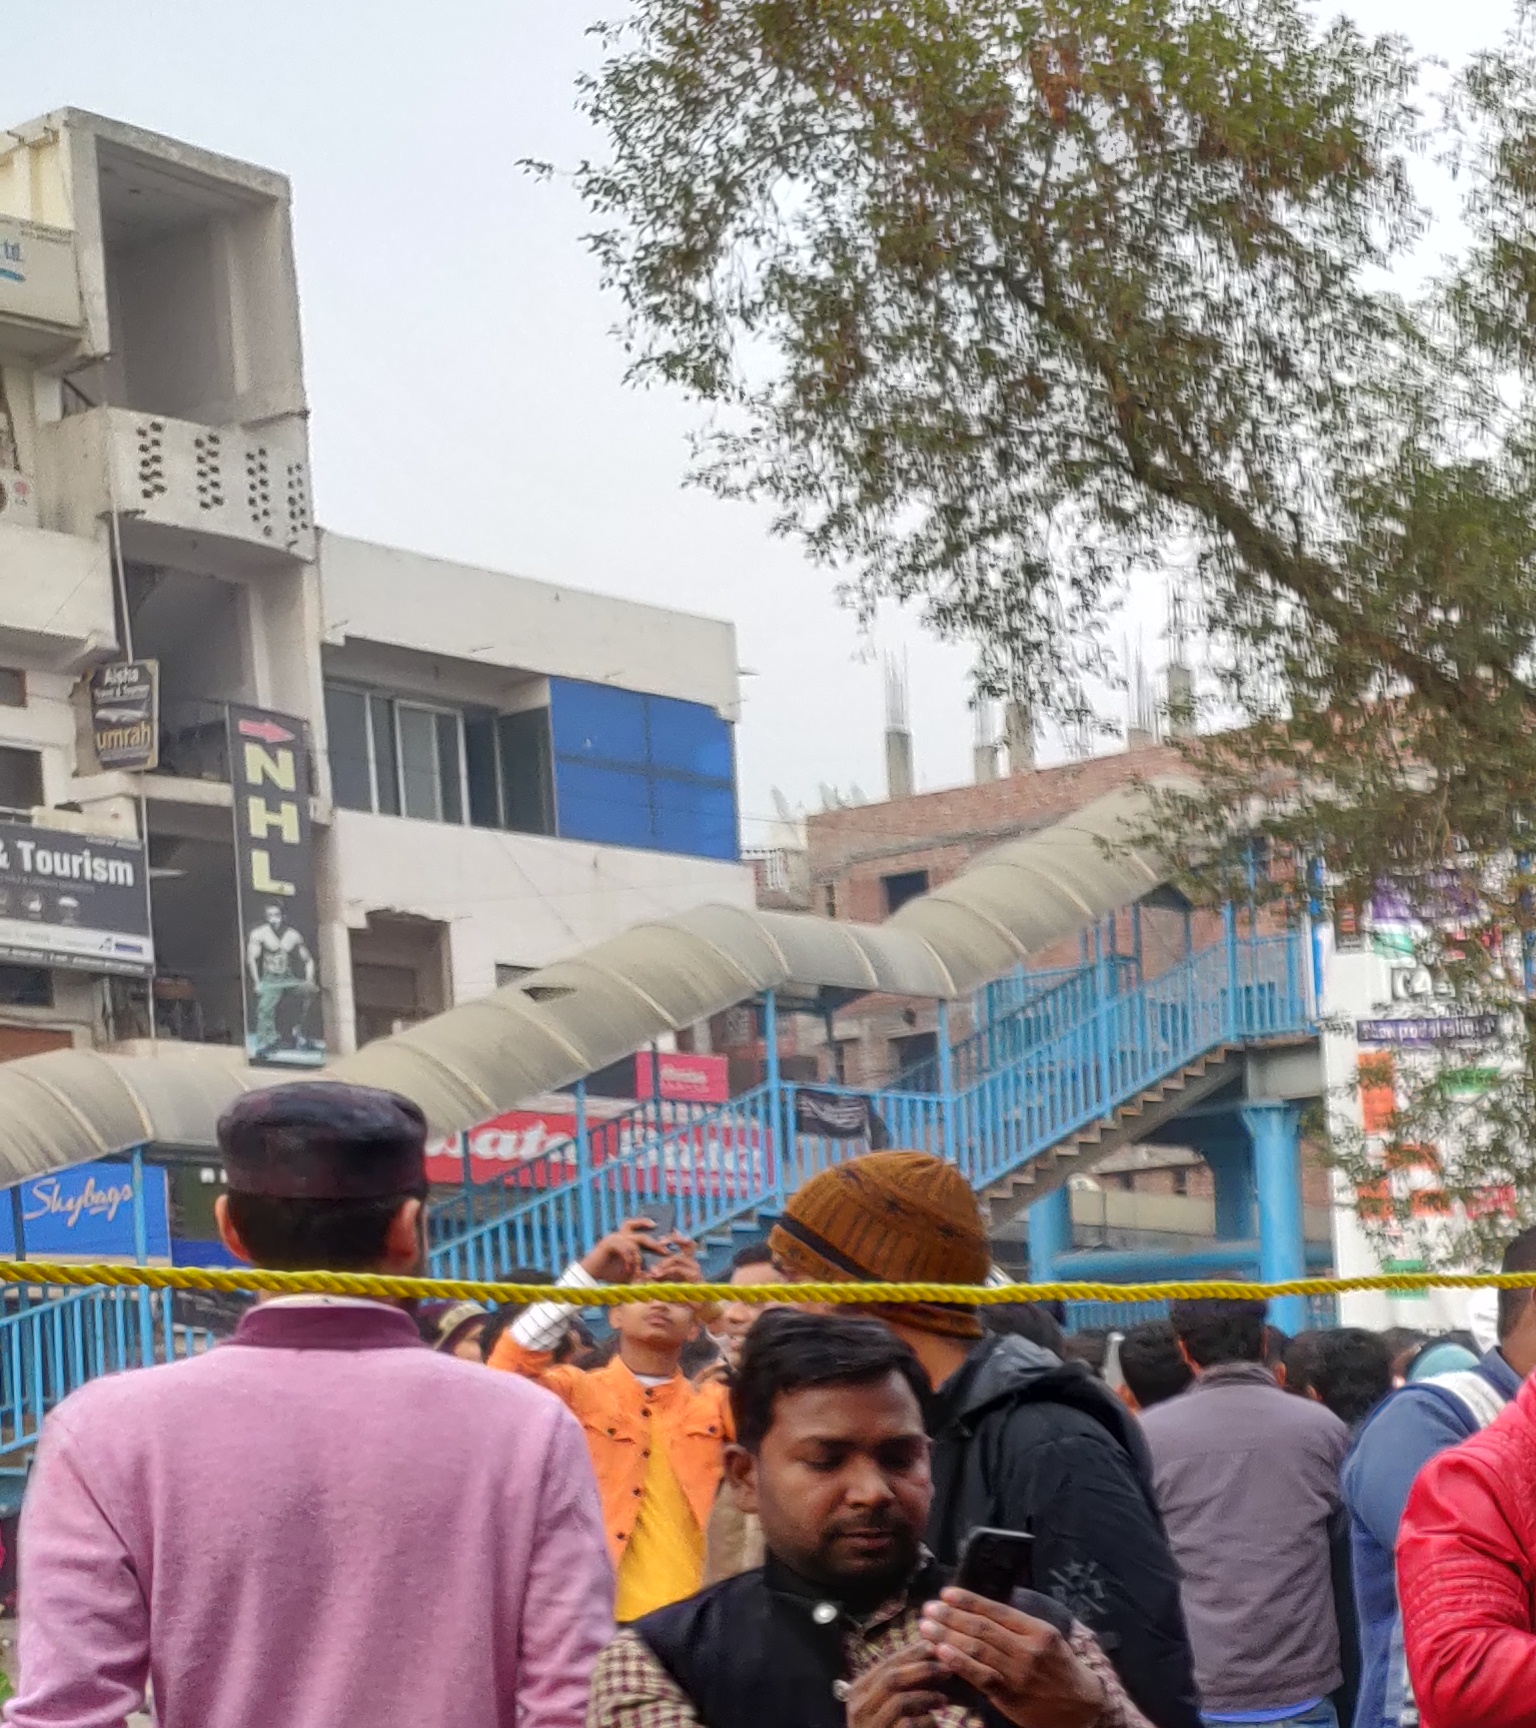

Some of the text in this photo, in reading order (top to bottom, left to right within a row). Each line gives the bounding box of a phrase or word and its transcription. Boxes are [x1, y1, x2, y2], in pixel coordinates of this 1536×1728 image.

[244, 742, 300, 896] NHL
[16, 839, 135, 887] Tourism
[24, 1176, 134, 1228] Skybags
